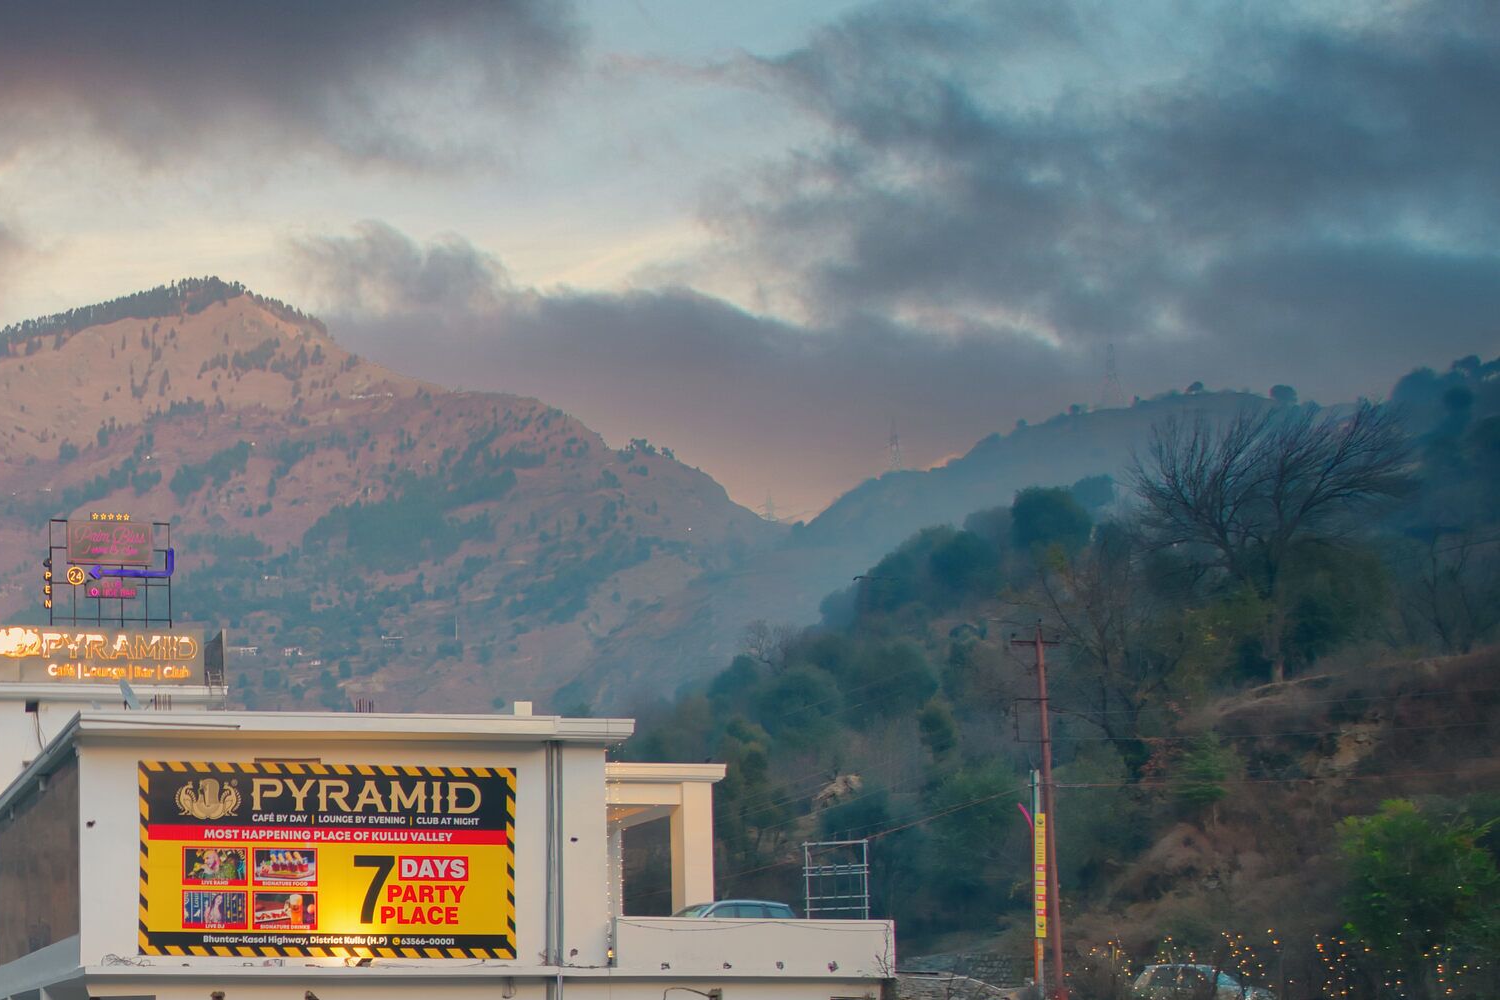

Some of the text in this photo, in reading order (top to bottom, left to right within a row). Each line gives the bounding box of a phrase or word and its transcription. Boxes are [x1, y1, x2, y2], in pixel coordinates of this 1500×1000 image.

[69, 571, 82, 582] 24
[42, 632, 198, 660] PYRAMID
[47, 663, 191, 679] Café Lounge Bar Club
[252, 778, 482, 814] PYRAMID
[252, 813, 480, 826] CAFÉ BY DAY LOUNGE BY EVENING CLUB AT NIGHT
[204, 829, 452, 842] MOST HAPPENING PLACE OF KULLU VALLEY
[353, 855, 466, 924] 7 DAYS
[387, 885, 465, 904] PARTY
[380, 906, 459, 925] PLACE
[203, 935, 454, 946] Bhuntar-Kasol Highway, District Kullu (H.P) 63566-00001
